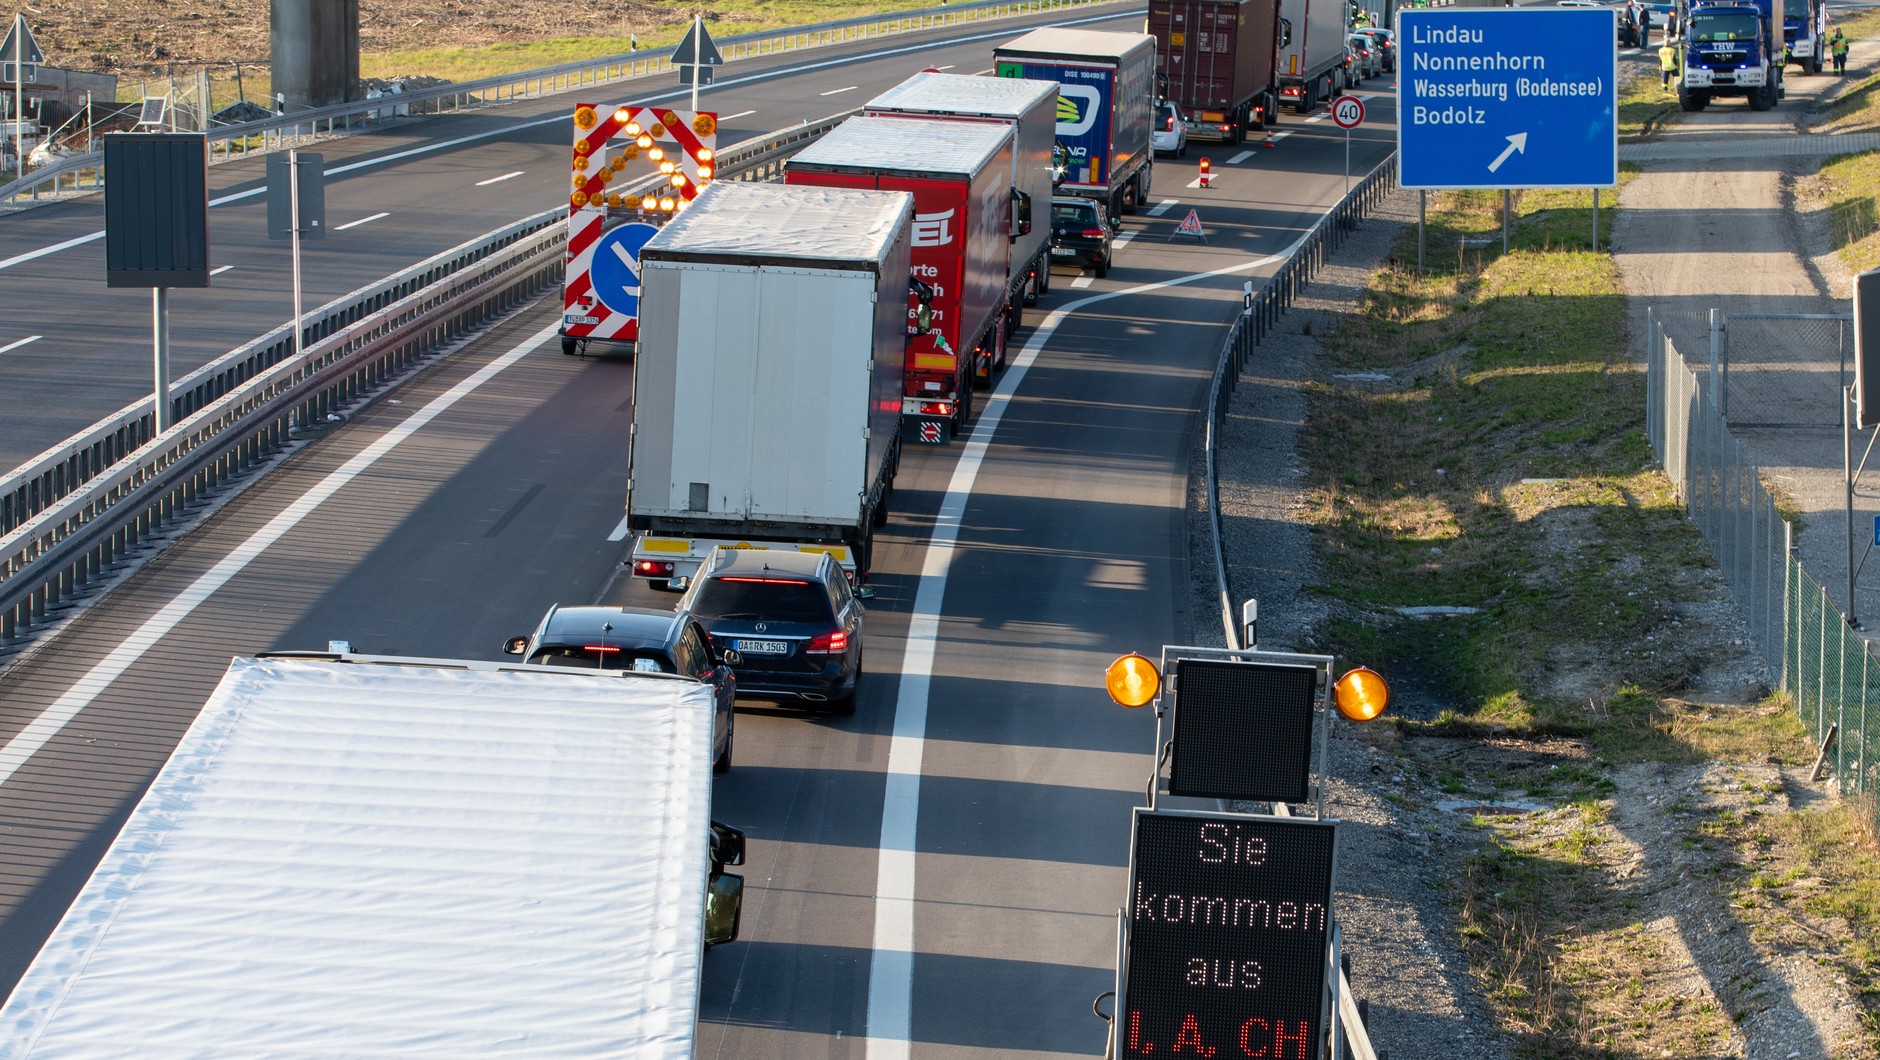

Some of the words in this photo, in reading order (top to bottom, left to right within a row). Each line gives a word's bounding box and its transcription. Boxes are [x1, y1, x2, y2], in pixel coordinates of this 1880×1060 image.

[1413, 25, 1483, 44] Lindau
[1712, 42, 1735, 50] THW
[1413, 52, 1545, 71] Nonnenhorn
[1064, 70, 1078, 78] DISE
[1414, 78, 1508, 102] Wasserburg
[1515, 76, 1603, 98] (Bodensee)
[1339, 105, 1358, 120] 40
[1413, 106, 1486, 125] Bodolz
[738, 640, 748, 650] OA
[754, 641, 764, 651] RK
[766, 642, 786, 652] 1503
[1199, 823, 1267, 865] Sie
[1136, 881, 1324, 931] kommen
[1186, 958, 1262, 989] aus
[1240, 1016, 1309, 1060] CH
